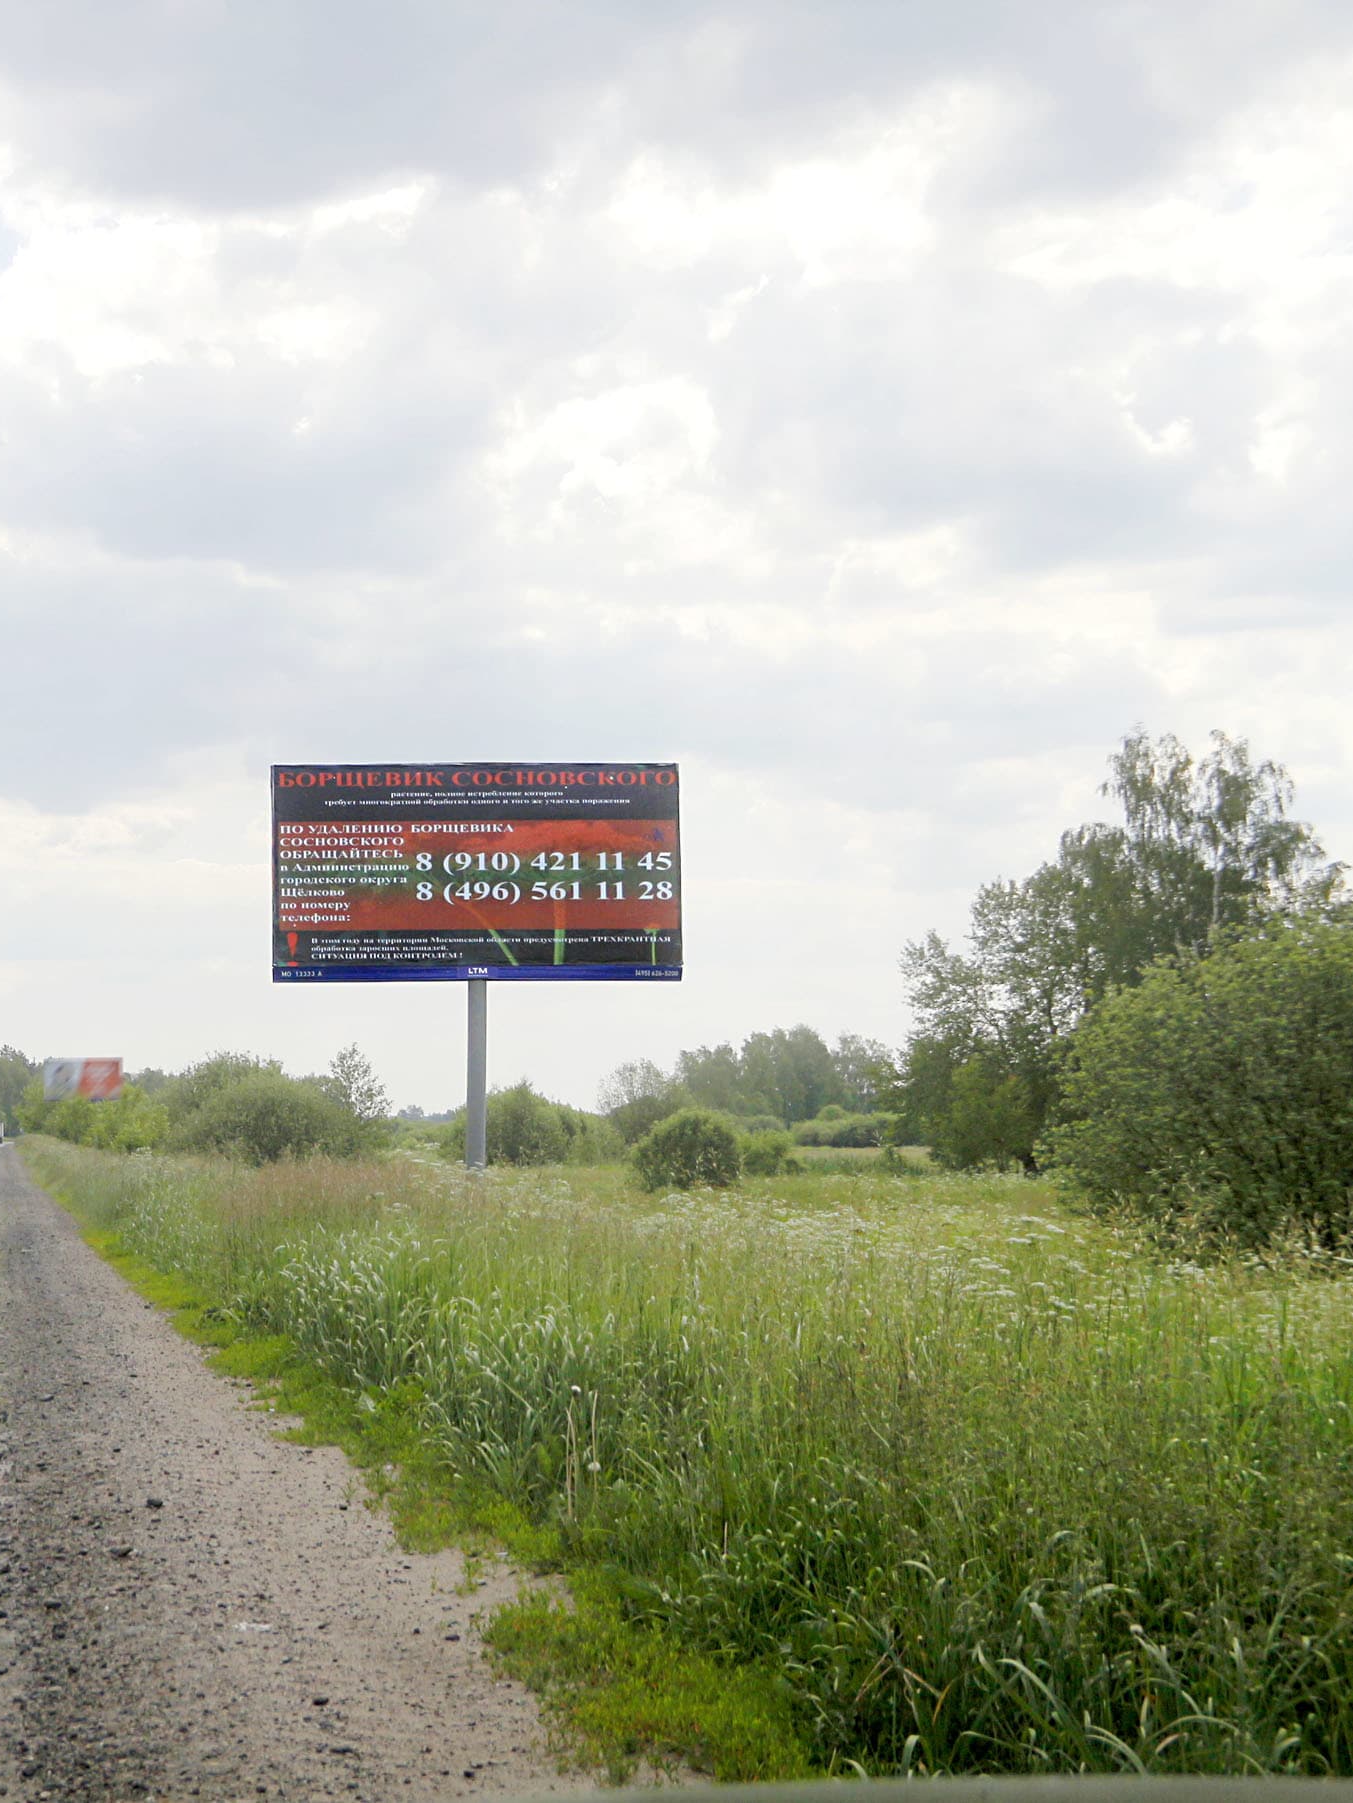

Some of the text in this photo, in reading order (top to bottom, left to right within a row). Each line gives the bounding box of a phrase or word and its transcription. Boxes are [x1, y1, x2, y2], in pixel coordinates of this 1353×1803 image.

[278, 771, 676, 788] БОРЩЕВИК СОСНОВСКОГО
[280, 823, 514, 835] ПО УДАЛЕНИЮ БОРЩЕВИКА
[280, 837, 405, 846] СОСНОВСКОГО
[280, 848, 404, 860] ОБРАЩАЙТЕСЬ
[292, 863, 409, 873] Администрацию
[415, 852, 673, 876] 8 (910) 421 11 45
[280, 876, 408, 885] городского округа
[281, 887, 345, 898] Щёлково
[415, 881, 673, 905] 8 (496) 561 11 28
[281, 902, 351, 911] по номеру
[281, 912, 351, 923] телефона:
